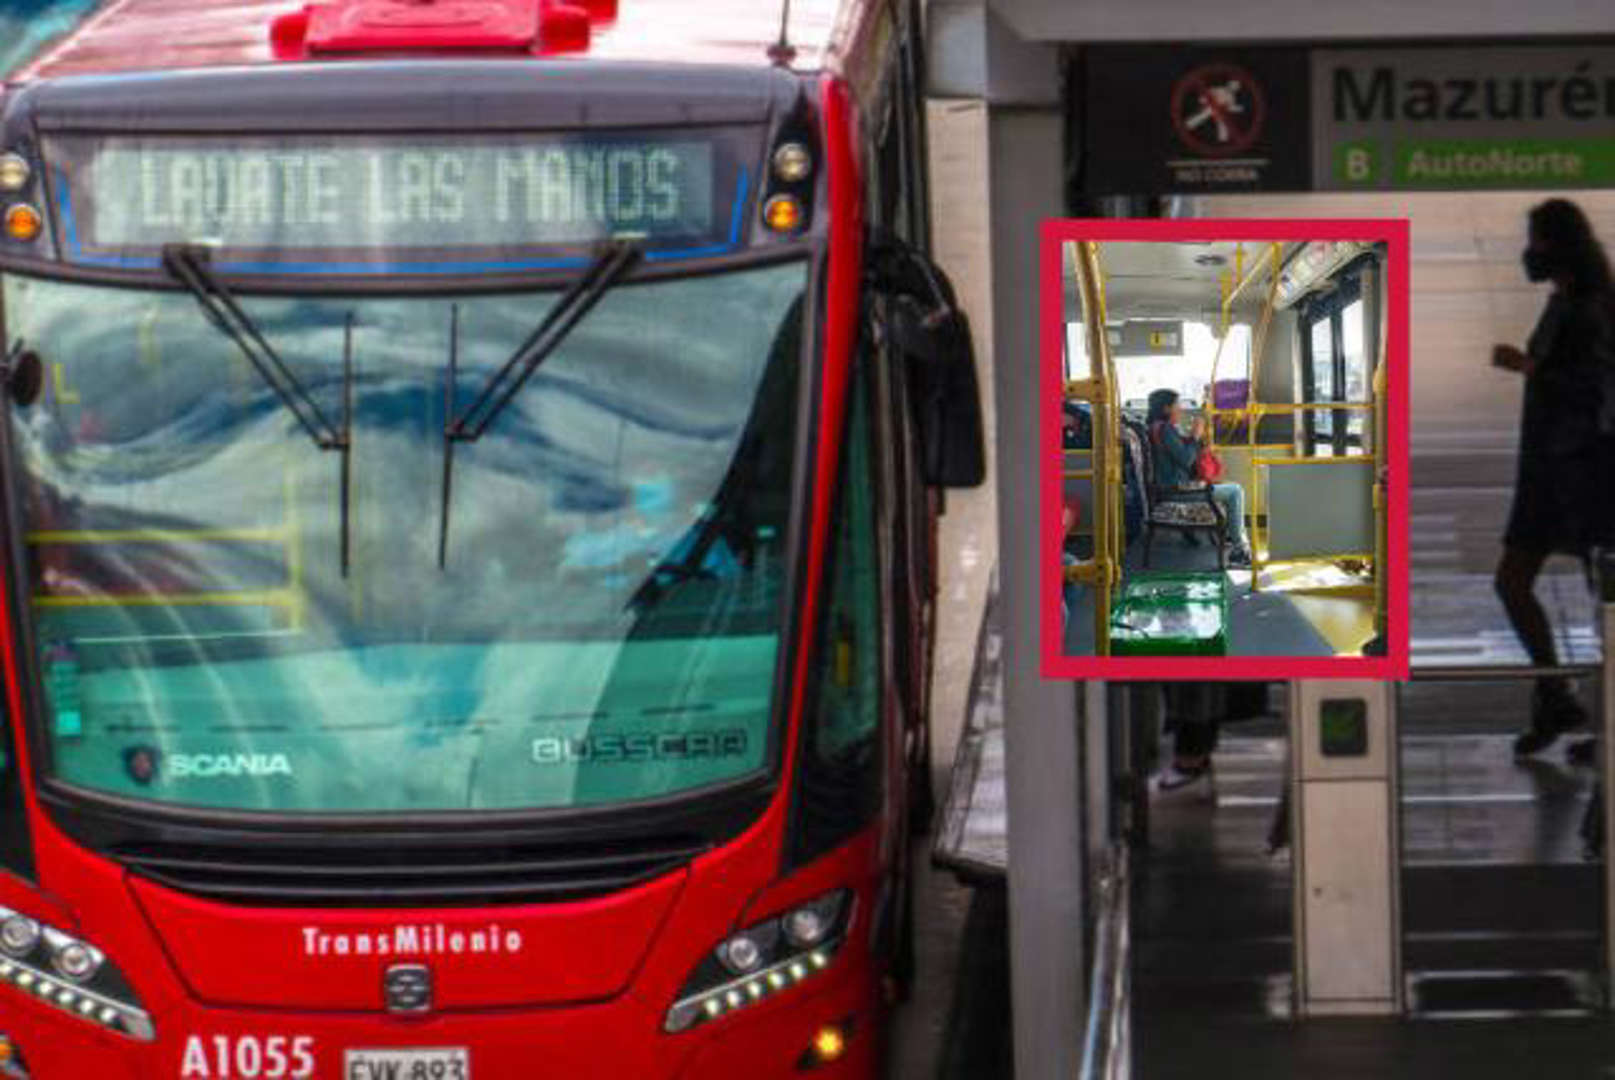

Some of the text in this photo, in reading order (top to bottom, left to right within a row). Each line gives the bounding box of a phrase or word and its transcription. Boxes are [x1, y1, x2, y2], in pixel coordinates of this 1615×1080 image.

[1346, 149, 1581, 180] B AutoNorte
[367, 150, 464, 223] LAS
[495, 148, 678, 222] MANOS
[168, 752, 291, 776] SCANIA
[302, 924, 522, 955] TransMilenio
[181, 1035, 315, 1077] A1055
